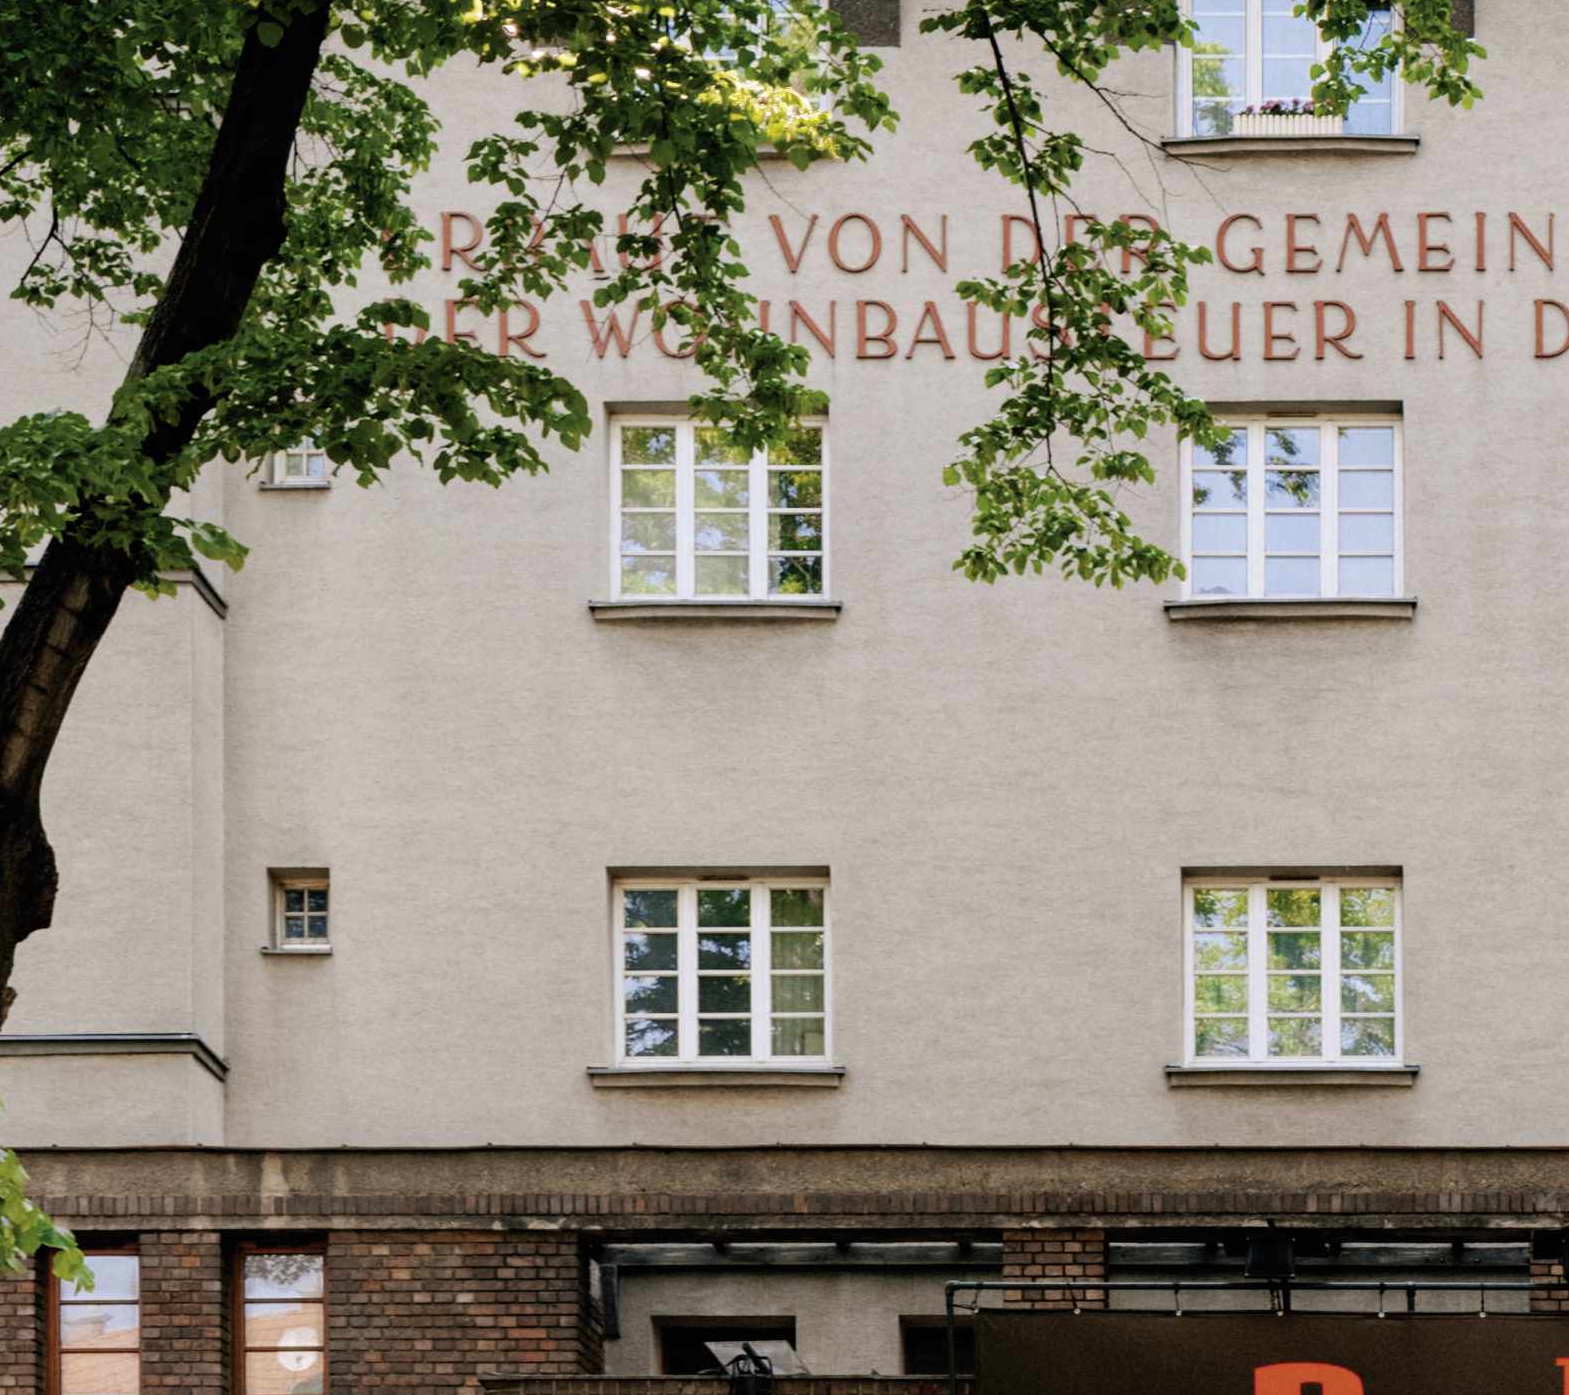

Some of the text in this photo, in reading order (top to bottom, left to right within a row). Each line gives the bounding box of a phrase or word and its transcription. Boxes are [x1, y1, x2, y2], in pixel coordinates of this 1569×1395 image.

[768, 212, 948, 274] VON
[1001, 213, 1172, 274] DER
[1404, 299, 1485, 360] IN
